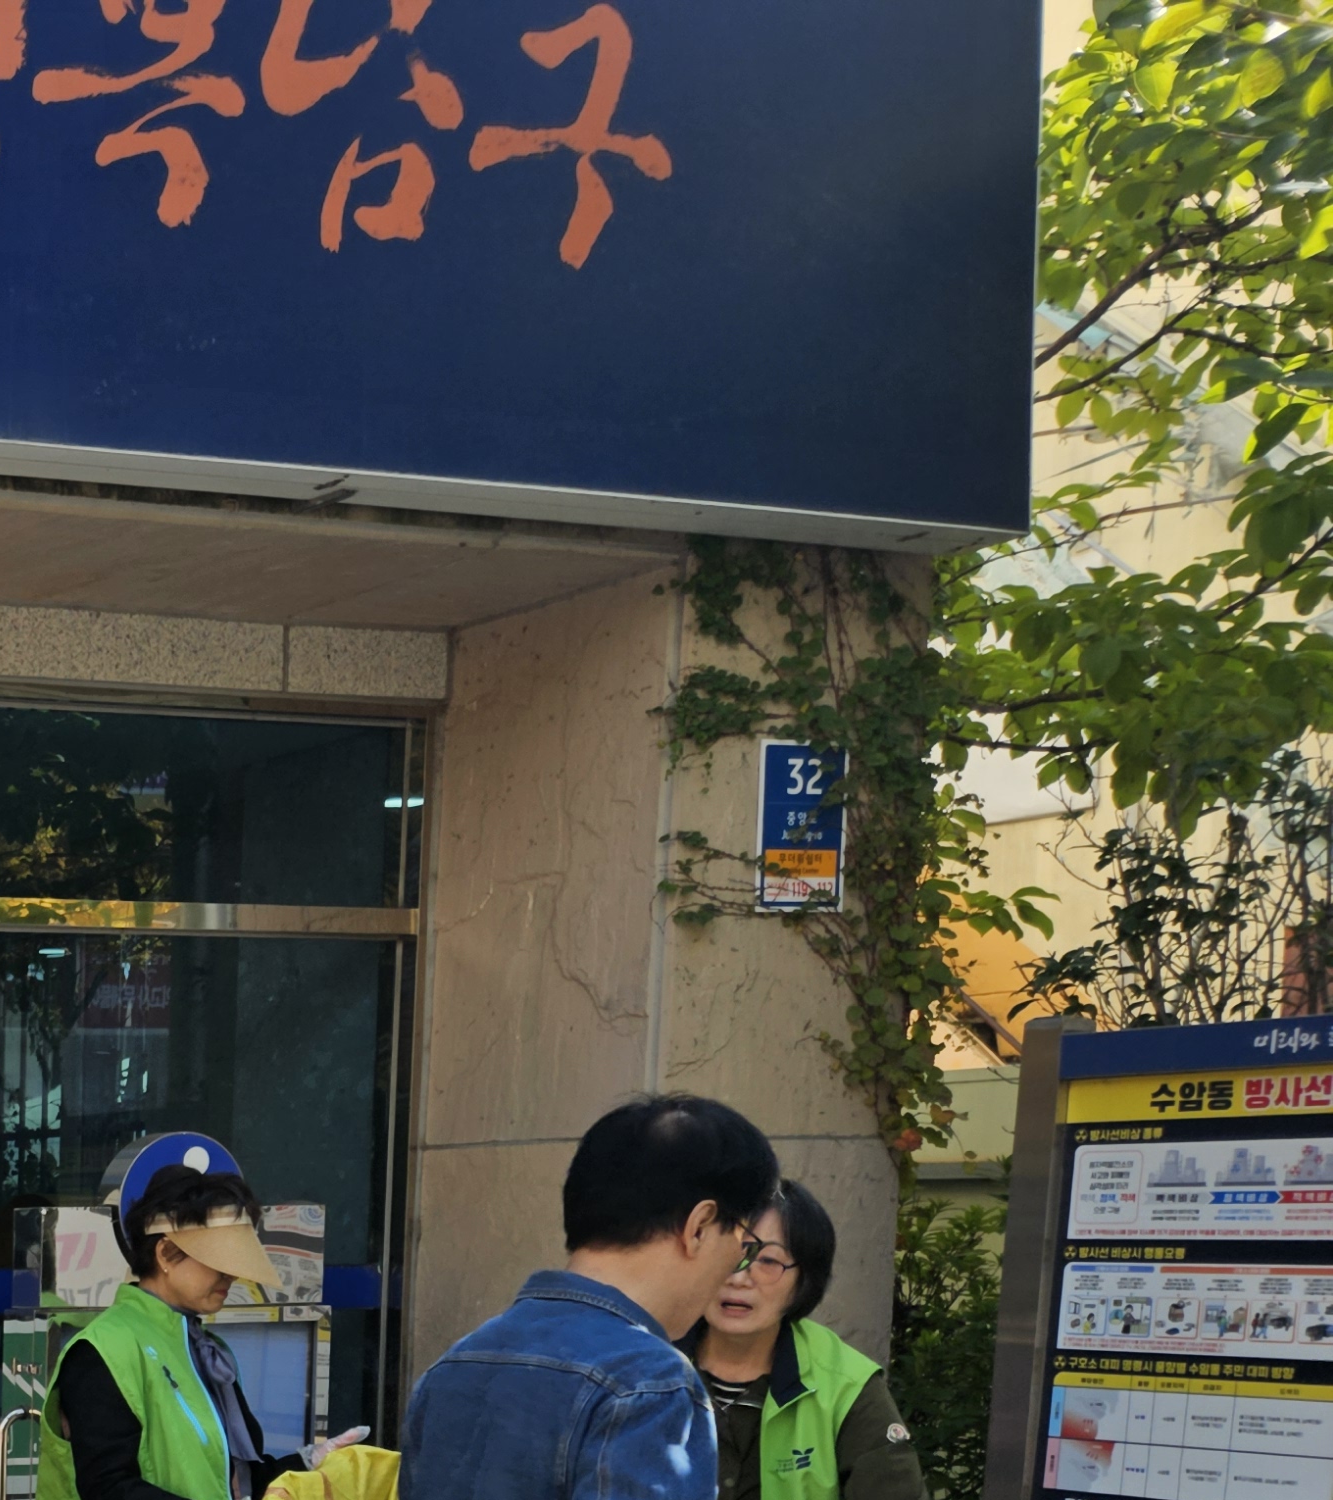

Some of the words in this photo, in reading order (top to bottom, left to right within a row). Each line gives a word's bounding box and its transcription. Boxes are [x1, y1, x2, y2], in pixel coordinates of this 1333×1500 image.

[787, 758, 823, 795] 32
[1253, 1027, 1320, 1054] 미래와
[1149, 1081, 1234, 1113] 수암동
[1244, 1075, 1333, 1111] 방사선
[1090, 1128, 1141, 1142] 방사선비상
[1078, 1247, 1108, 1259] 방사선
[1111, 1247, 1142, 1259] 비상시
[1068, 1356, 1097, 1369] 구호소
